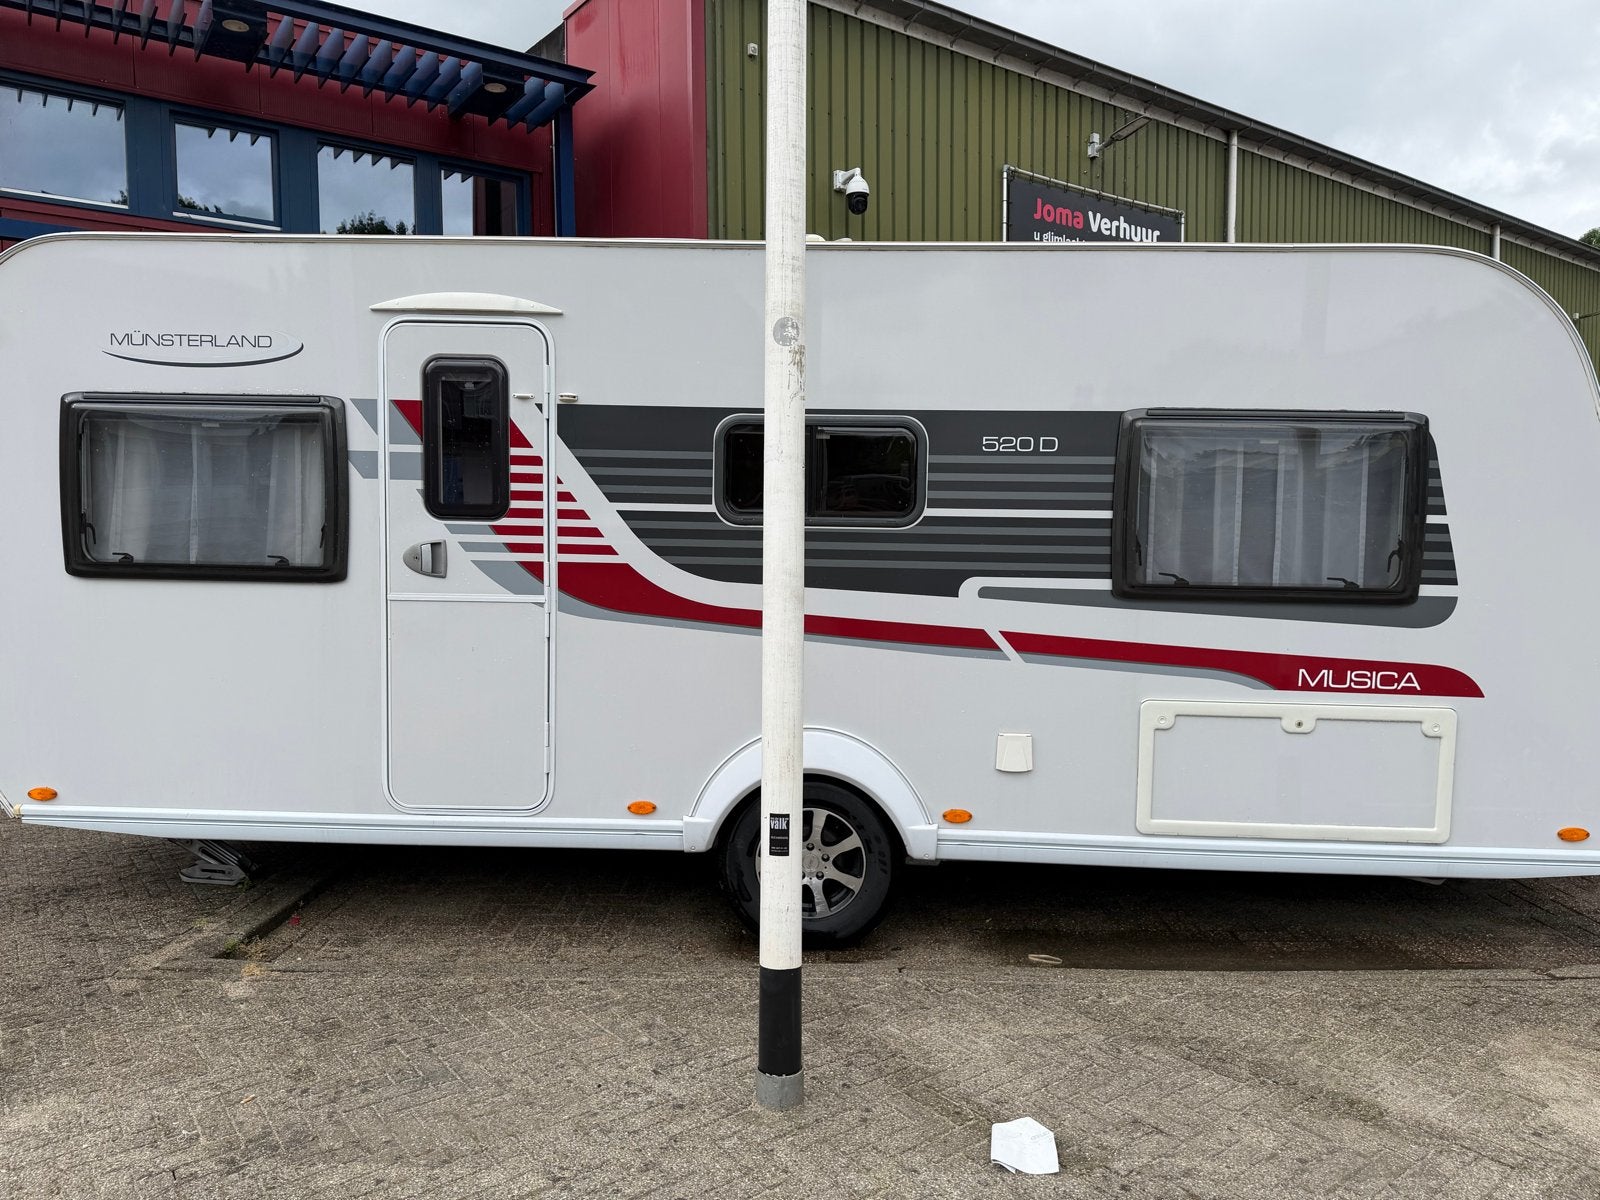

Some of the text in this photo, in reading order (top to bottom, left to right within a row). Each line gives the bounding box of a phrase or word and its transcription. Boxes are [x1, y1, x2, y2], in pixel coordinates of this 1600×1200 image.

[1033, 197, 1161, 242] Joma Verhuur
[1033, 231, 1040, 241] u
[110, 330, 273, 348] MÜNSTERLAND
[982, 436, 1059, 452] 520 D
[1297, 668, 1422, 691] MUSICA
